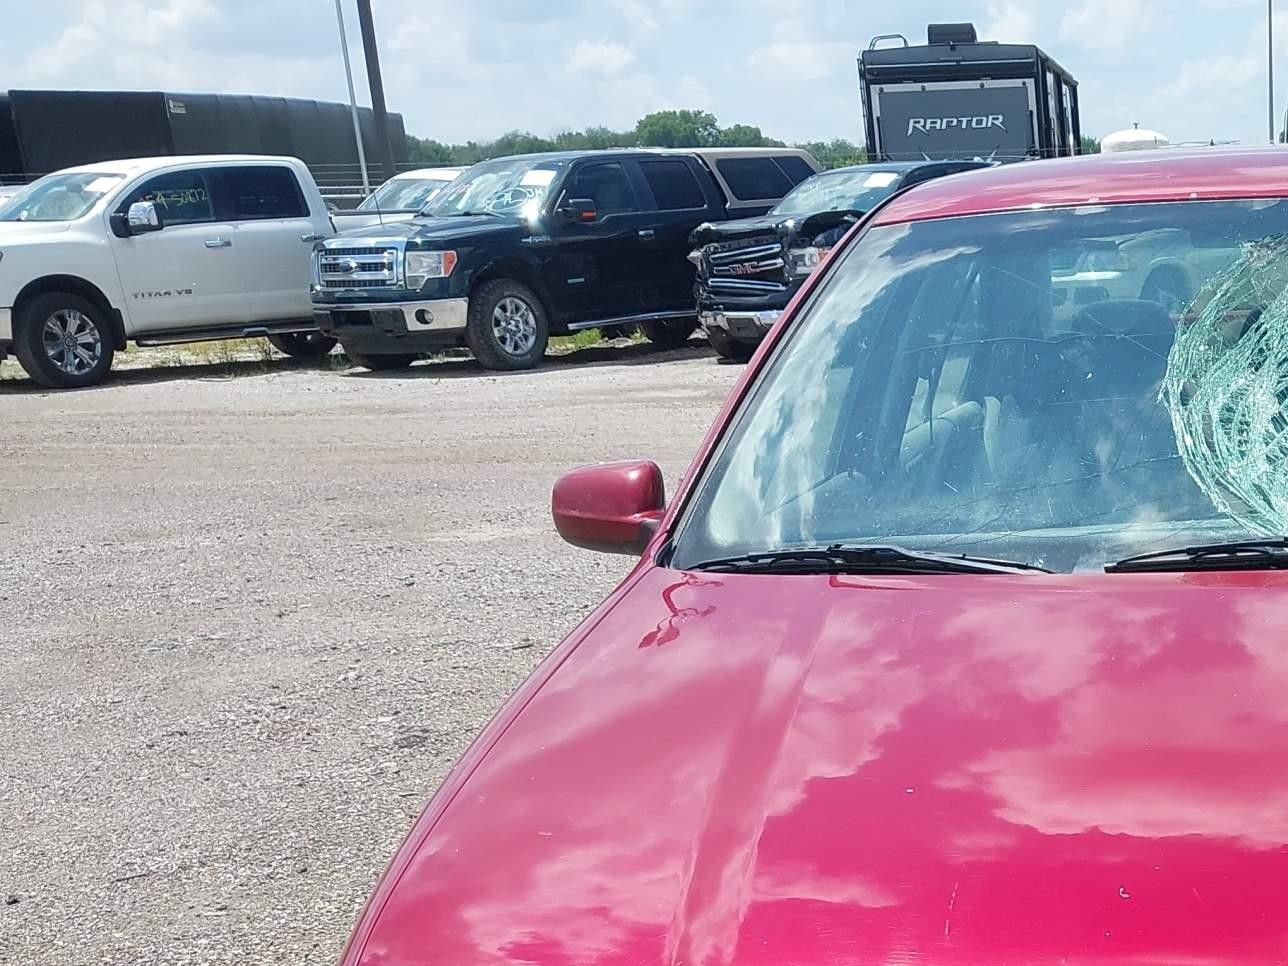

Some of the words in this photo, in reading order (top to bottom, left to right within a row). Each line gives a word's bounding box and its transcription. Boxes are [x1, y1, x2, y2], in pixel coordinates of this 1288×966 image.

[906, 114, 1008, 136] RAPTOR
[728, 261, 758, 275] GMC
[132, 291, 172, 299] TITAN
